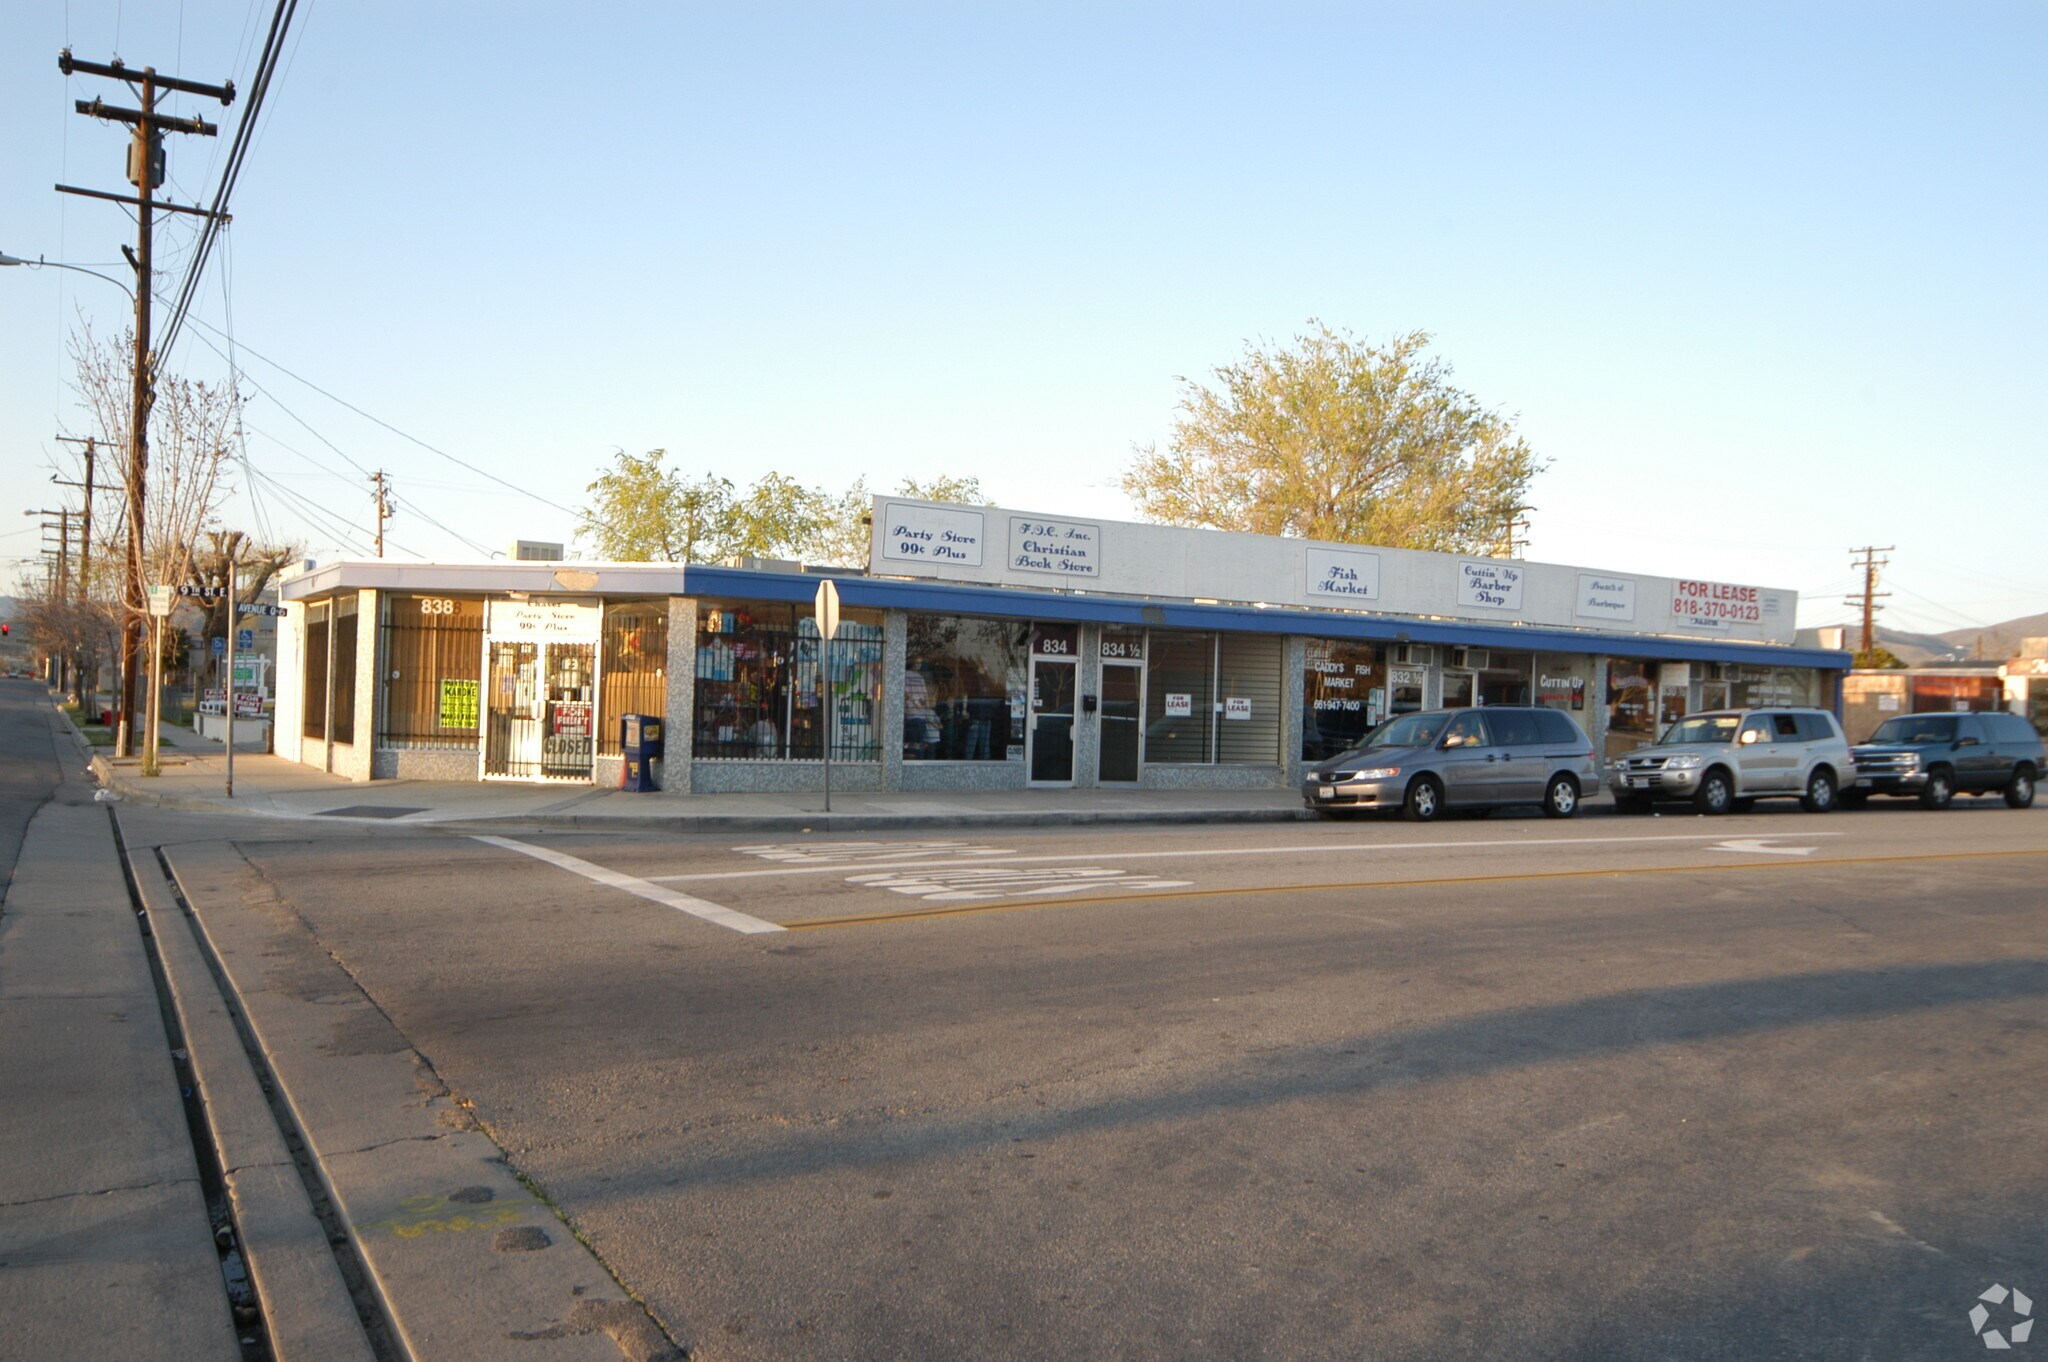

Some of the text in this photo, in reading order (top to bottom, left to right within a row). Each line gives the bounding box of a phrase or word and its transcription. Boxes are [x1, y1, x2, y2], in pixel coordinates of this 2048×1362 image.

[893, 525, 976, 544] Party Store
[932, 545, 967, 559] Plus
[1023, 540, 1087, 558] Christian
[1015, 555, 1093, 573] Book Store
[1328, 566, 1358, 581] Fish
[1317, 580, 1368, 595] Market
[1469, 577, 1512, 592] Barber
[1679, 580, 1758, 603] FOR LEASE
[1475, 590, 1505, 606] Shop
[238, 603, 267, 615] AVENUE
[421, 598, 454, 615] 838
[1674, 598, 1760, 621] 818-370-0123
[1042, 638, 1068, 654] 834
[1101, 642, 1126, 657] 834
[1355, 664, 1372, 676] FISH
[1391, 670, 1411, 684] 832
[1324, 676, 1356, 688] MARKET
[240, 694, 259, 702] FOR
[545, 738, 591, 755] CLOSED
